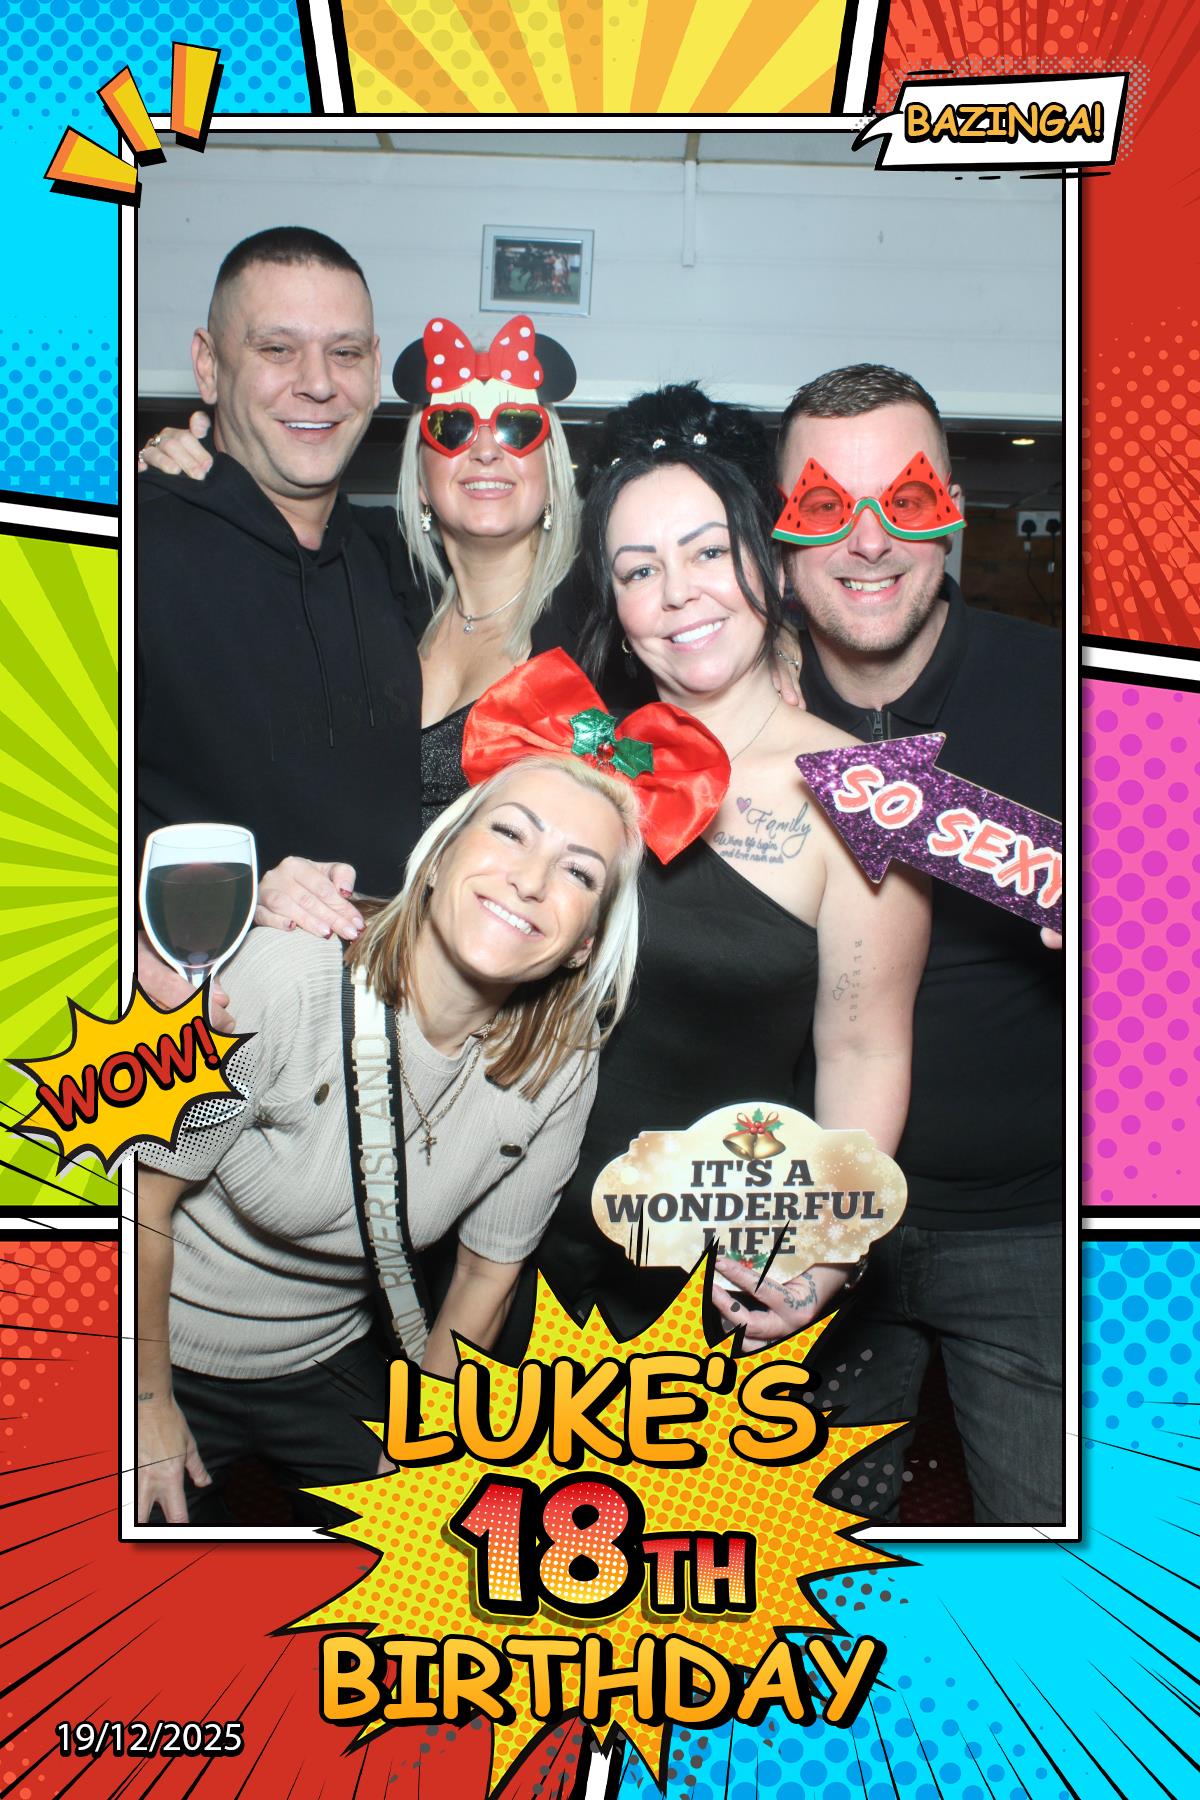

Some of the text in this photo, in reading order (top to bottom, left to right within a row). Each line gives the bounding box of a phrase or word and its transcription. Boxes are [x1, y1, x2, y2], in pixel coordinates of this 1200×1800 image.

[833, 764, 923, 829] SO
[747, 802, 812, 859] Family
[351, 1033, 399, 1186] ISLAND
[690, 1159, 815, 1187] IT'S A
[603, 1191, 884, 1223] WONDERFUL
[364, 1198, 416, 1289] RIVER
[702, 1226, 796, 1255] LIFE
